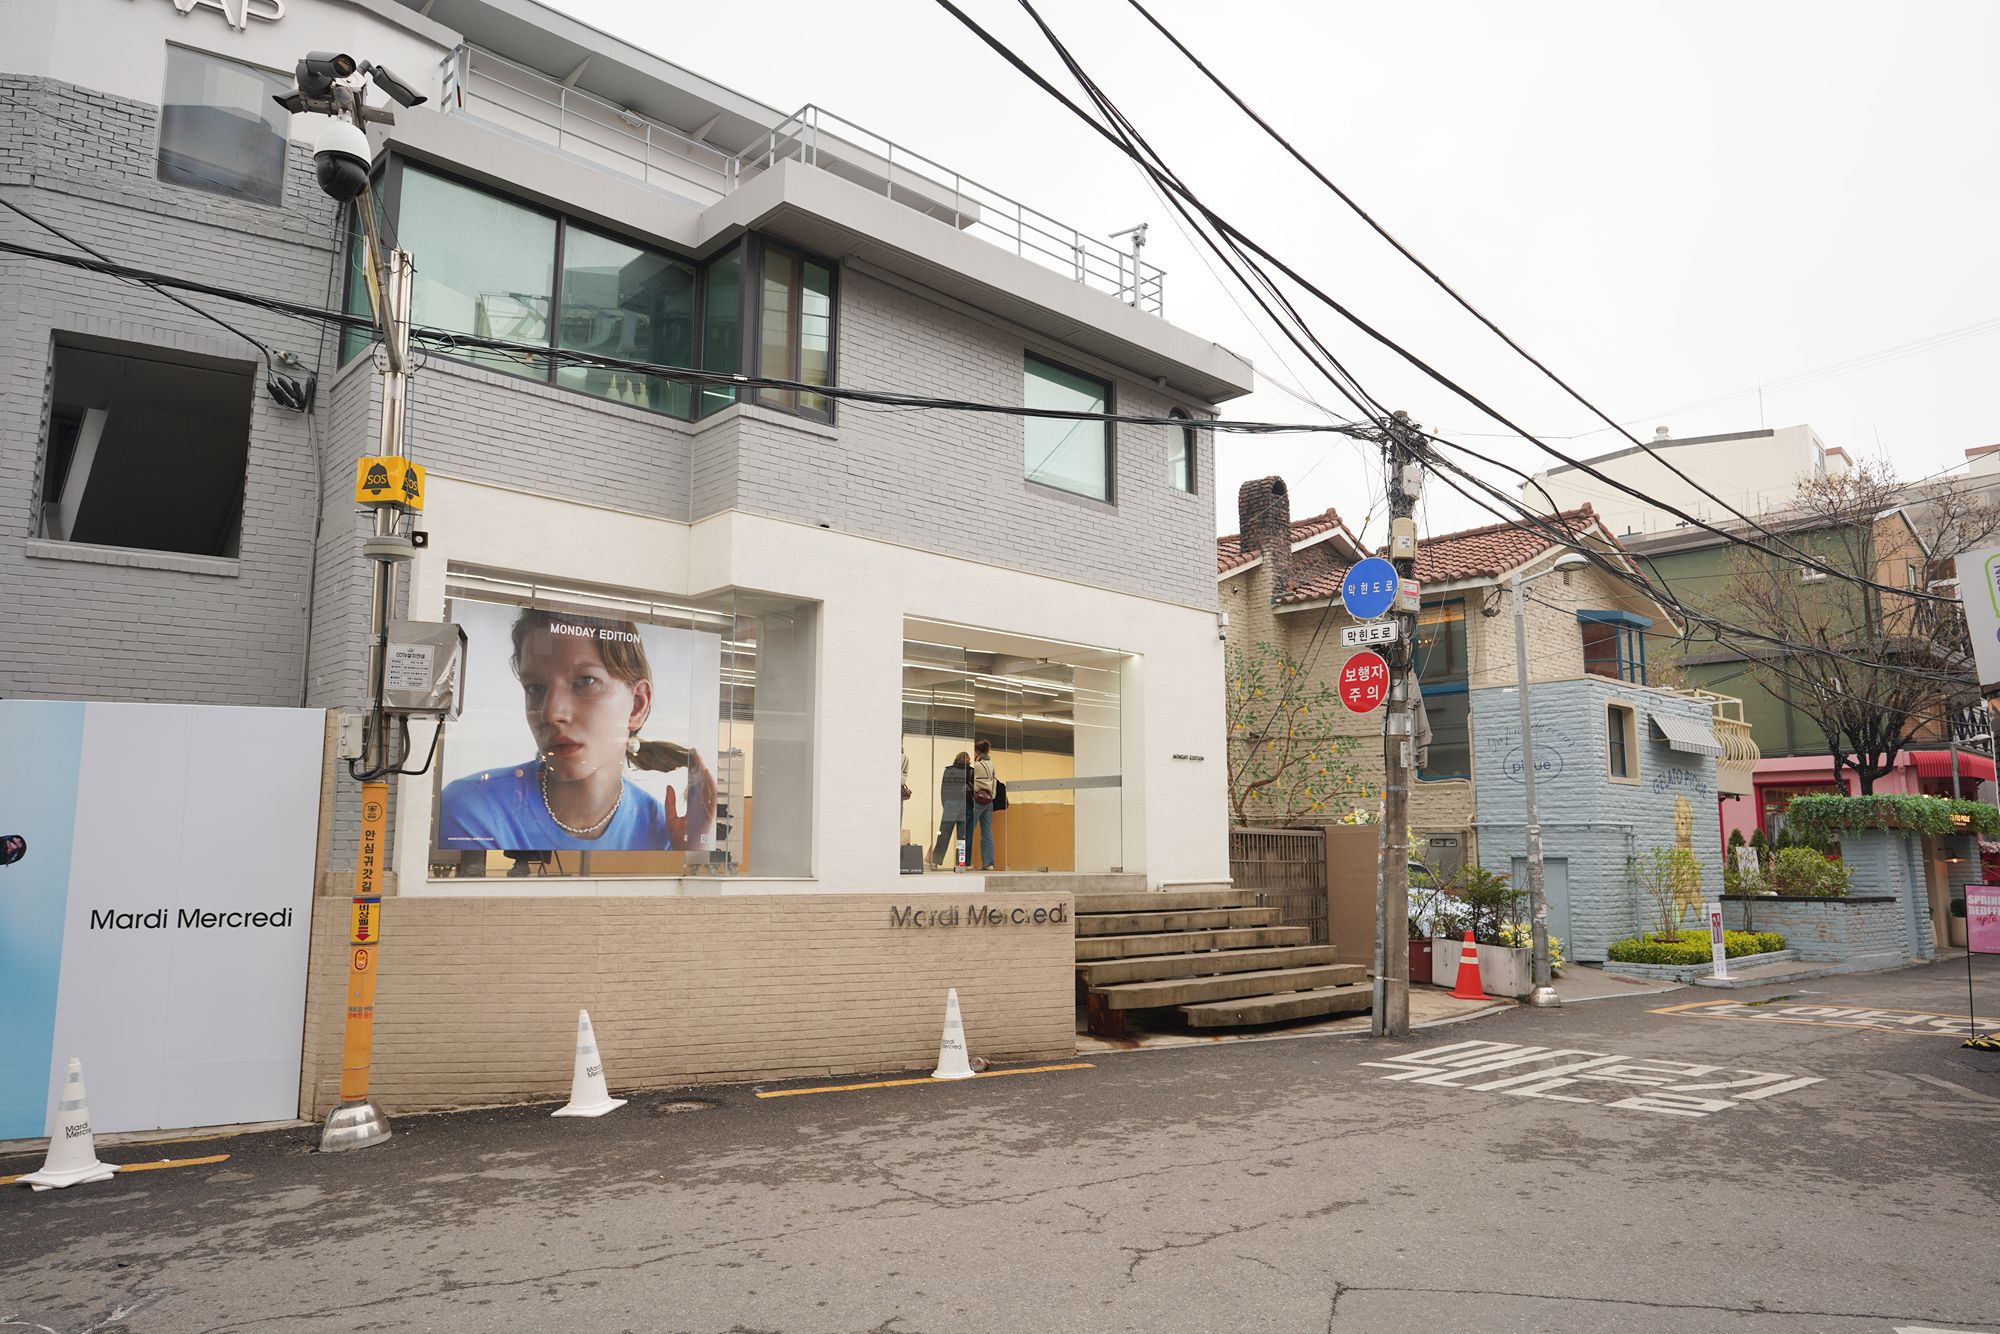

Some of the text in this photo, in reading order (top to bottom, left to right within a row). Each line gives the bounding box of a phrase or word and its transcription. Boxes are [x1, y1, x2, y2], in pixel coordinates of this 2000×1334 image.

[367, 474, 387, 485] SOS
[405, 478, 418, 491] SOS
[550, 622, 641, 643] MONDAY EDITION
[1347, 627, 1391, 642] 막힌도로
[1345, 664, 1384, 682] 보행자
[1349, 684, 1379, 702] 주의
[1512, 760, 1552, 774] piue
[362, 829, 376, 893] 안심귀갓길
[1967, 895, 2000, 905] SPRIN
[90, 908, 293, 929] Mardi Mercredi
